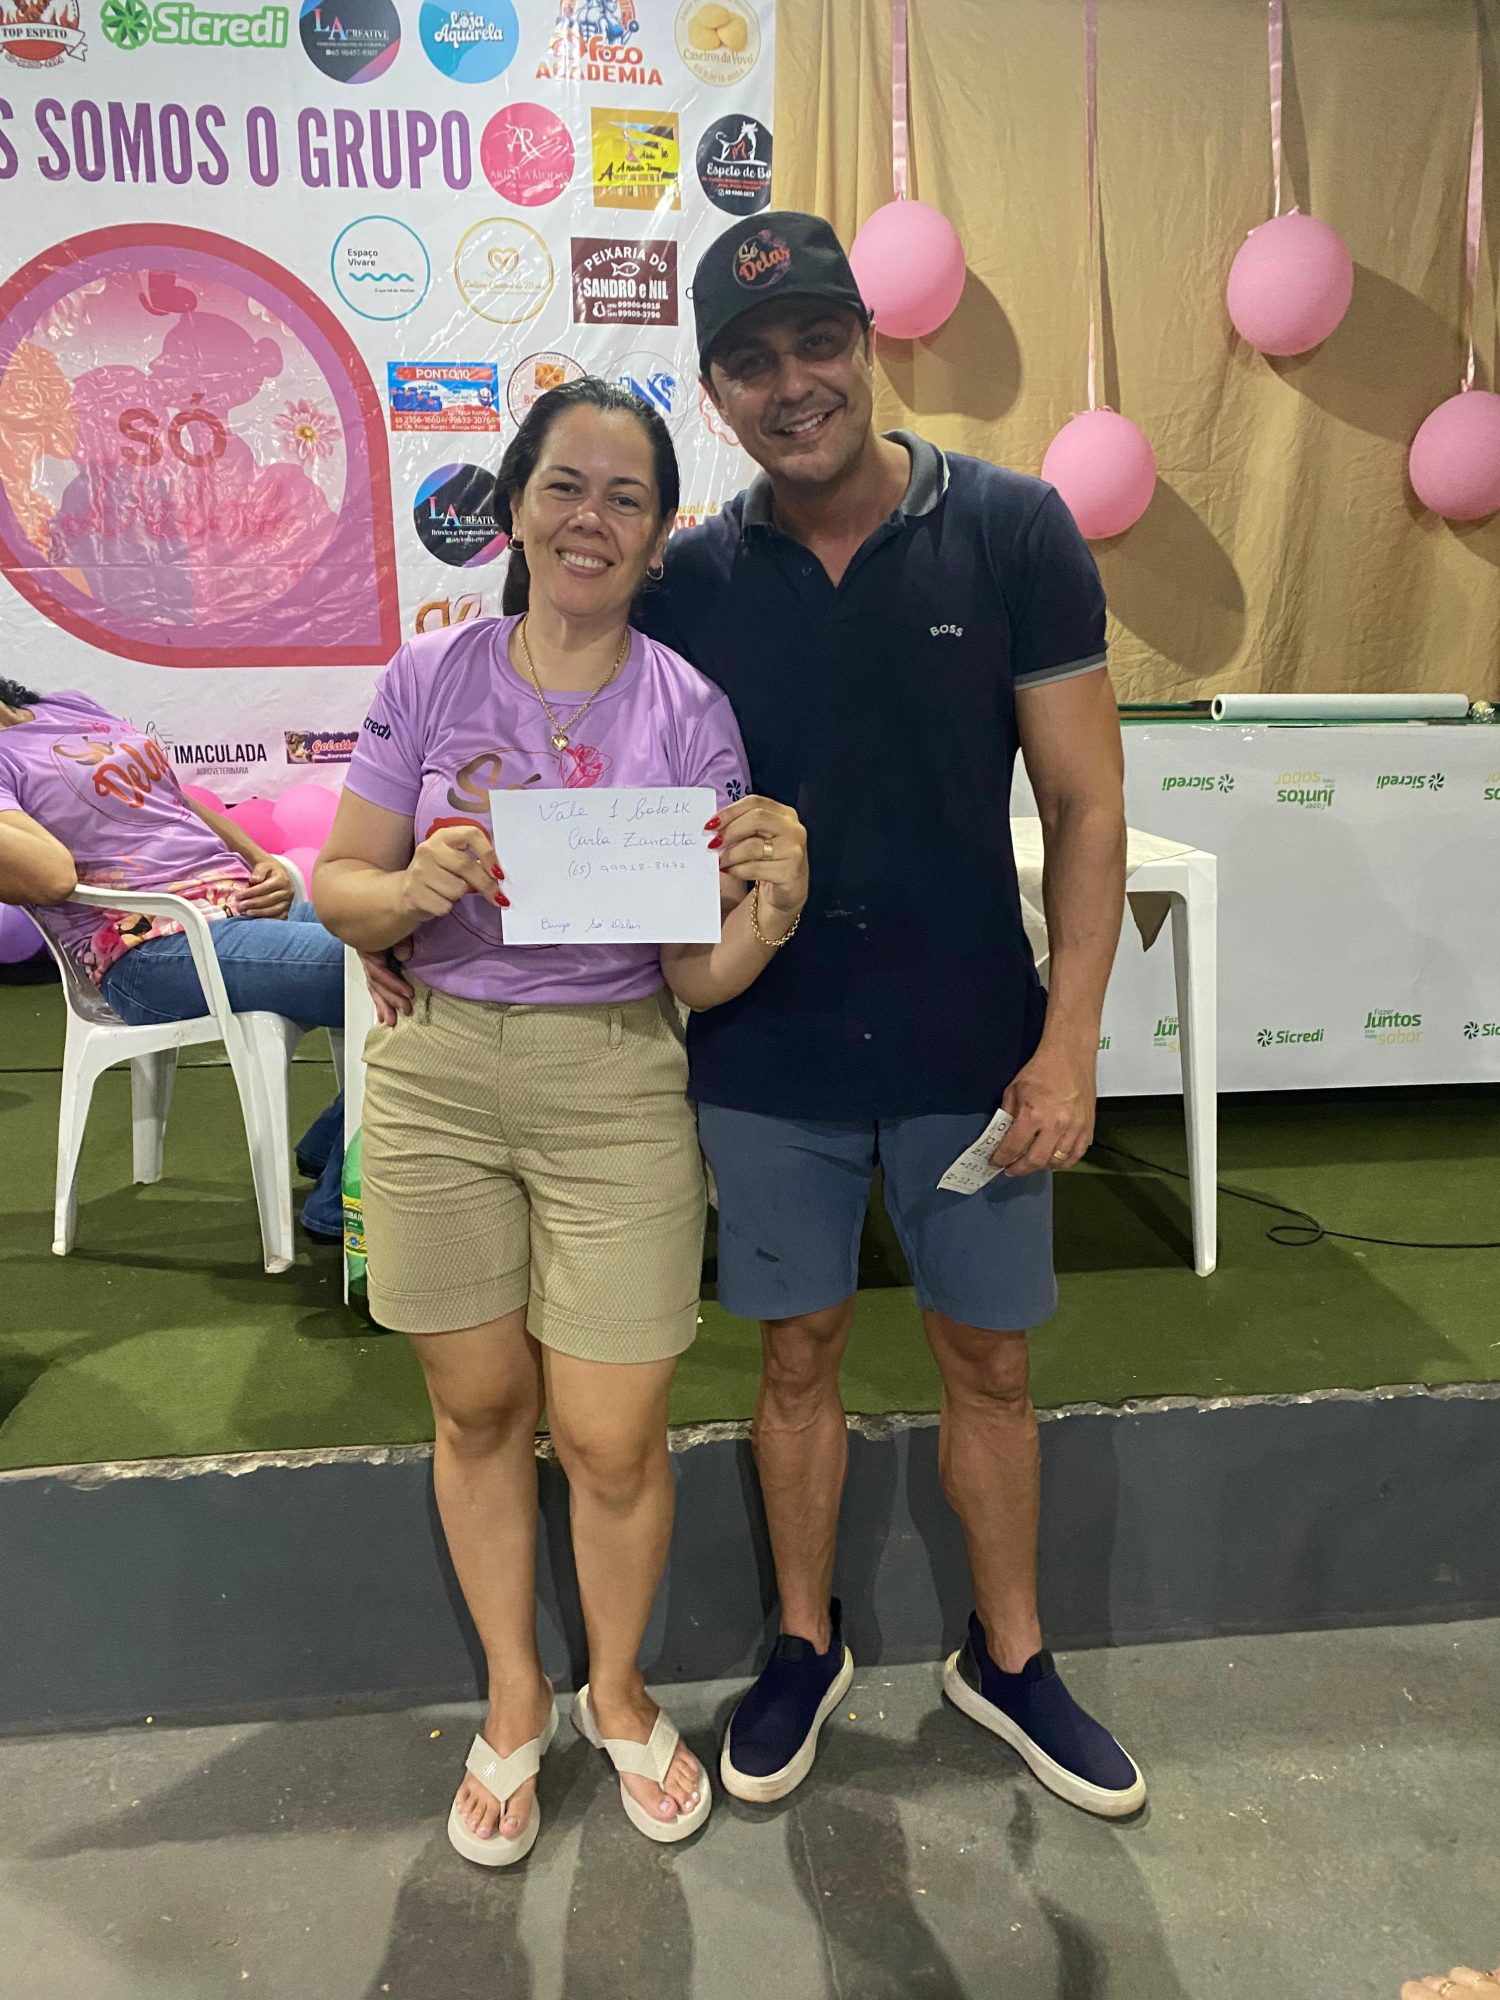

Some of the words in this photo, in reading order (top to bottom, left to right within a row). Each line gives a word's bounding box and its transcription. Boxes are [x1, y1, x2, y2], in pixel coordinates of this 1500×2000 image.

[151, 3, 288, 48] Sicredi
[450, 10, 485, 29] Loja
[2, 27, 23, 37] TOP
[26, 27, 68, 39] ESPETO
[434, 22, 504, 48] Aquarela
[34, 97, 229, 186] SOMOS
[246, 105, 279, 187] O
[297, 107, 472, 190] GRUPO
[742, 166, 756, 178] de
[347, 248, 379, 258] Espaço
[583, 246, 646, 272] PEIXARIA
[649, 253, 668, 273] DO
[739, 242, 758, 262] Só
[347, 259, 376, 267] Vivare
[739, 244, 790, 281] Delas
[583, 278, 636, 299] SANDRO
[639, 283, 647, 299] e
[648, 279, 669, 300] NIL
[118, 393, 228, 468] SÓ
[929, 624, 964, 637] BOSS
[174, 743, 268, 764] IMACULADA
[1162, 776, 1215, 791] Sicredi
[1376, 775, 1427, 789] Sicredi
[1276, 789, 1336, 807] Juntos
[539, 800, 589, 821] Vale
[568, 860, 591, 880] (65)
[1364, 1011, 1422, 1029] Juntos
[1275, 1028, 1325, 1044] Sicredi
